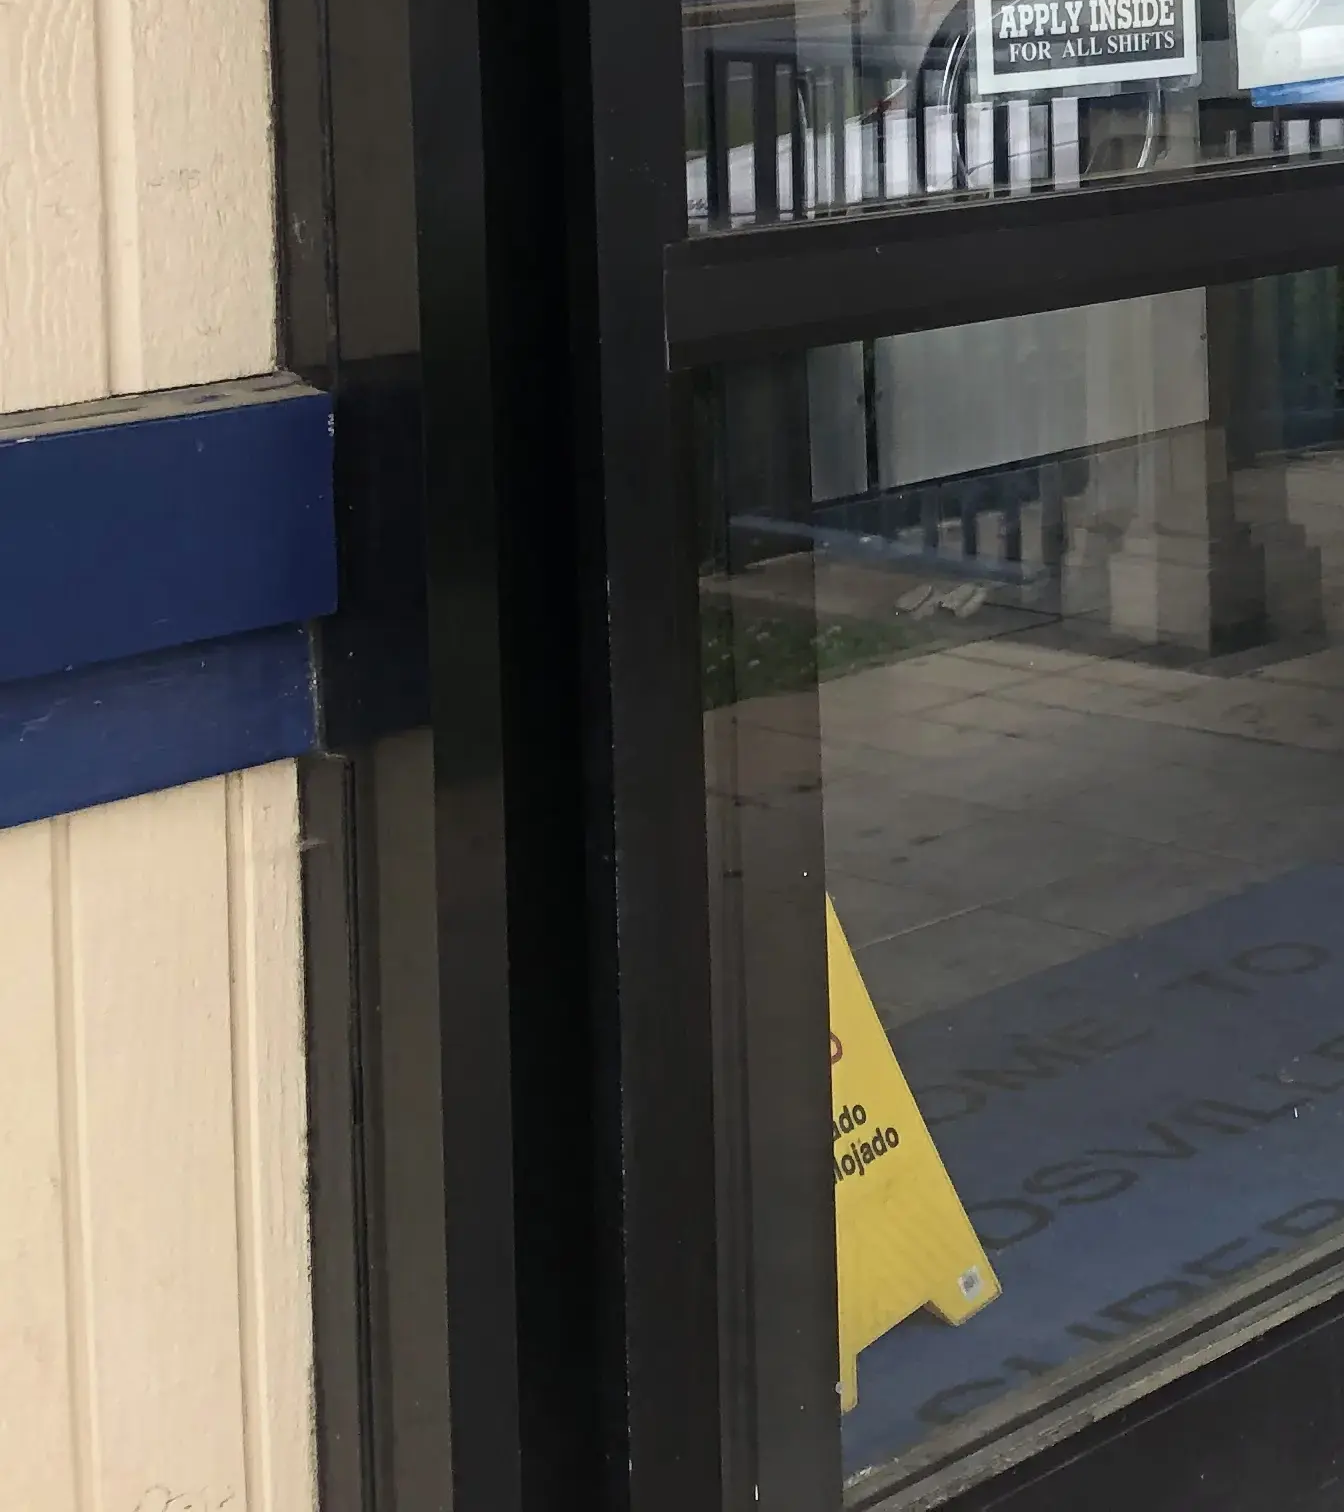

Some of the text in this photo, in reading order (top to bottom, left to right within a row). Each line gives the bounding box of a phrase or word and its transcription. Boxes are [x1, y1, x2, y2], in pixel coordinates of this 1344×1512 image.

[999, 1, 1083, 39] APPLY
[1009, 30, 1175, 63] FOR ALL SHIFTS
